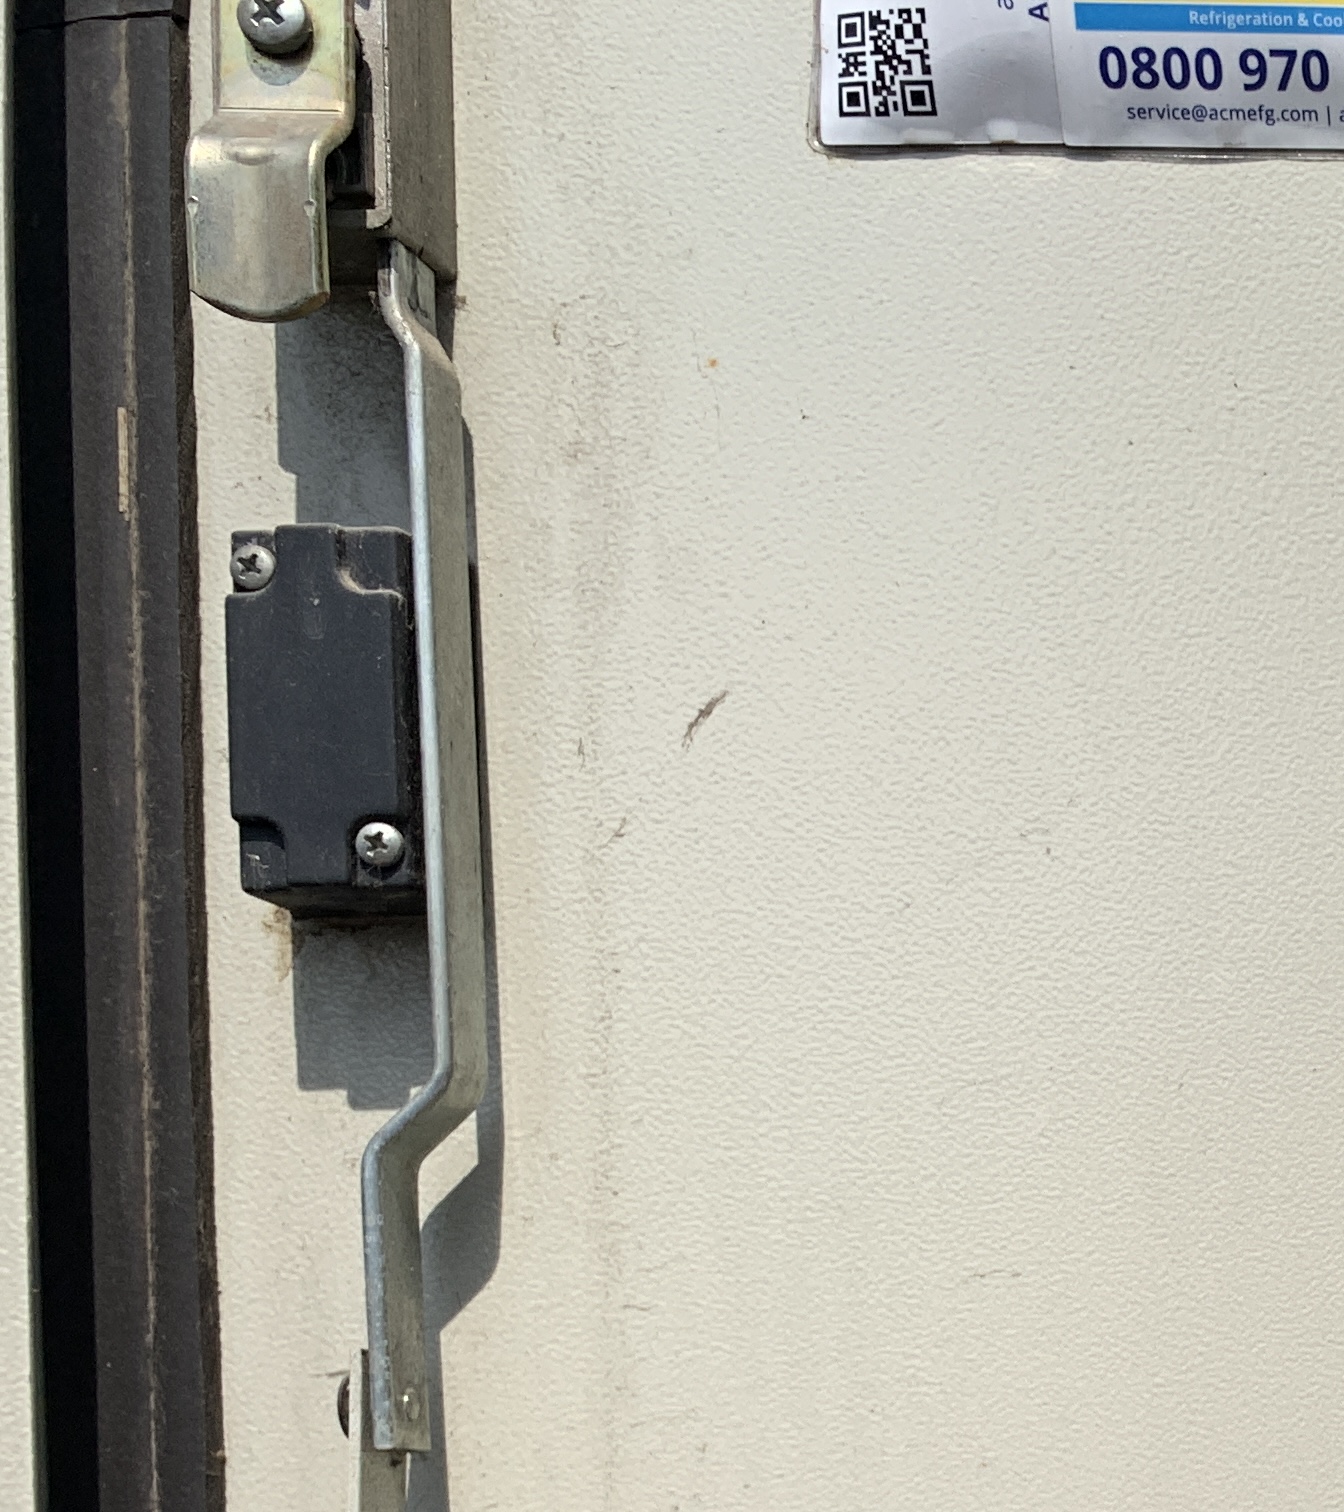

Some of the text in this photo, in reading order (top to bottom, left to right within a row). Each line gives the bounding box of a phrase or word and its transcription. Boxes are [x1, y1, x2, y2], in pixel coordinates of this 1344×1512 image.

[1188, 9, 1292, 31] Refrigeration
[1297, 12, 1308, 27] &
[1099, 46, 1223, 92] 0800
[1239, 50, 1330, 92] 970
[1127, 104, 1319, 127] service@acmefg.com
